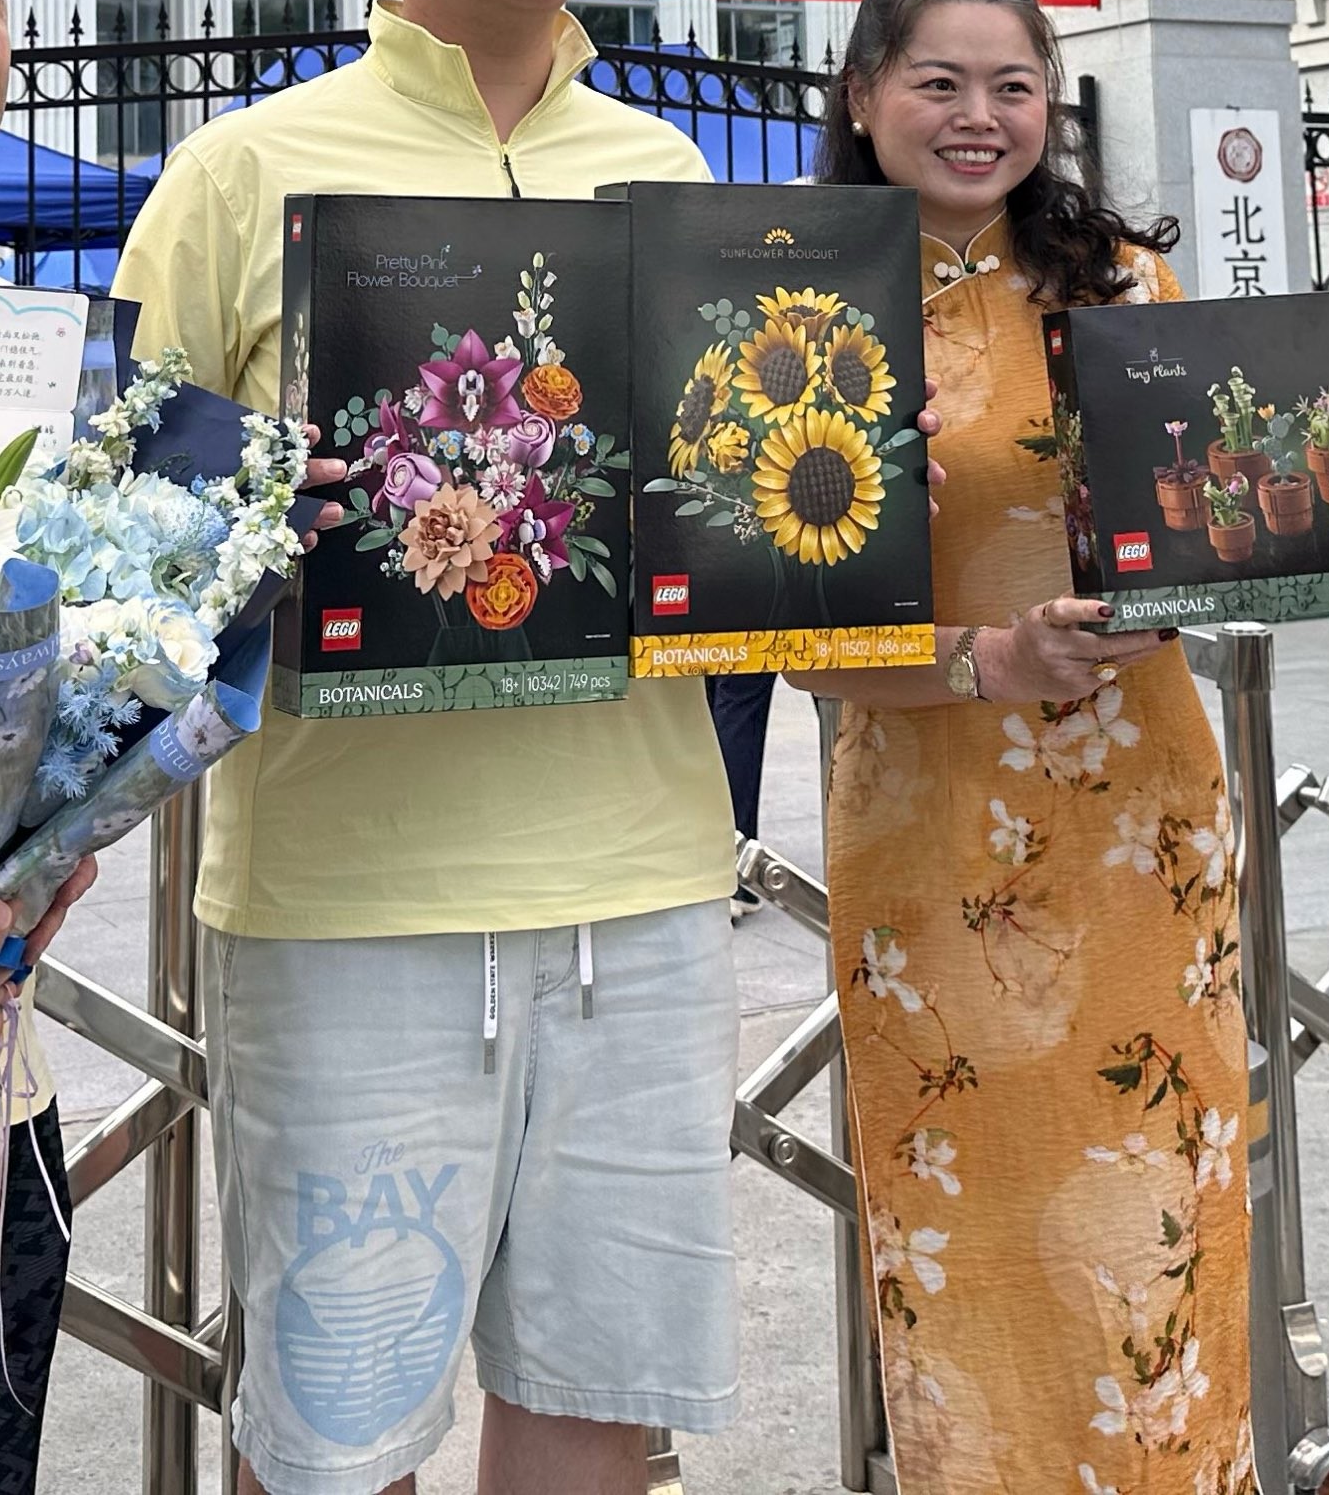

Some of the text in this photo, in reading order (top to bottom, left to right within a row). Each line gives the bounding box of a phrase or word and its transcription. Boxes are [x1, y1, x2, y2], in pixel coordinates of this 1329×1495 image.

[719, 248, 839, 260] SUNFLOWER BOUQUET
[1220, 195, 1268, 297] 北京
[376, 253, 448, 273] Pretty Pink
[347, 271, 460, 290] Flower Bouquet
[1125, 363, 1187, 384] Tiny Plants
[1118, 543, 1150, 561] LEGO
[654, 587, 688, 604] LEGO
[1121, 596, 1215, 619] BOTANICALS
[323, 620, 360, 639] LEGO
[652, 638, 921, 665] BOTANICALS 18+ 11502 686 pcs
[318, 673, 611, 705] BOTANICALS 18+ 10342 749 pcs
[353, 1138, 406, 1175] The
[296, 1162, 462, 1249] BAY
